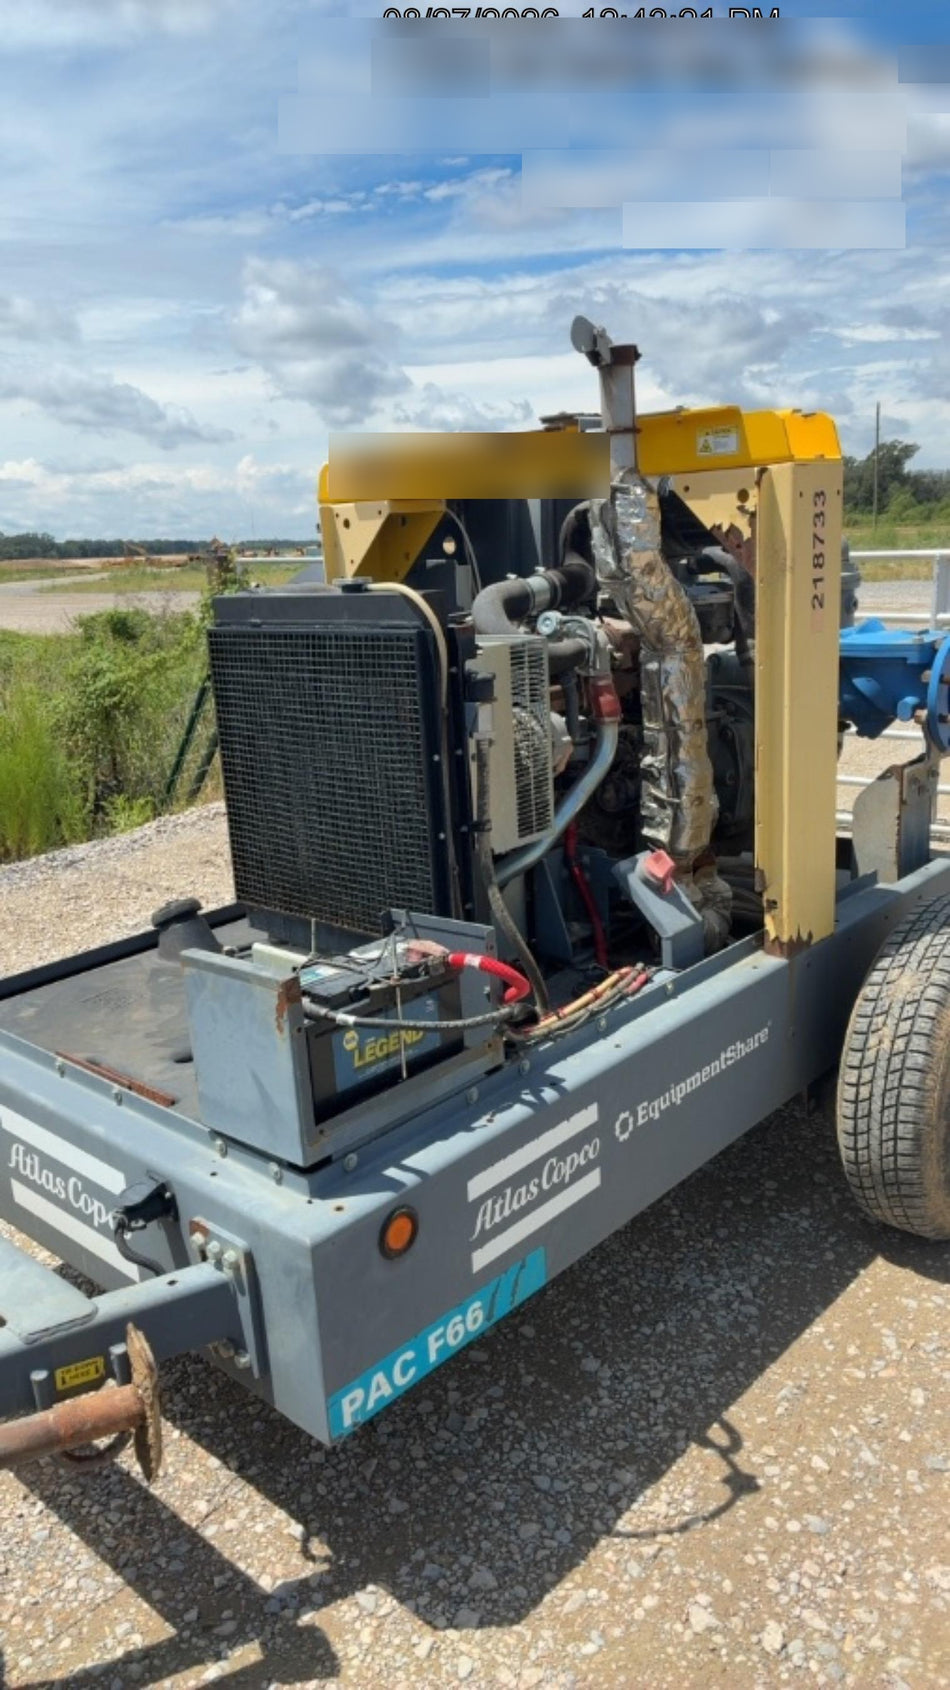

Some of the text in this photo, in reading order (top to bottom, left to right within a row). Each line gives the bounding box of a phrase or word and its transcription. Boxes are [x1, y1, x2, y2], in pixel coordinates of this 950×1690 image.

[811, 489, 826, 611] 218733
[636, 1027, 769, 1126] EquipmentShare
[8, 1143, 66, 1199] Atlas
[469, 1137, 600, 1242] Atlas Copco
[341, 1301, 484, 1428] PAC F66
